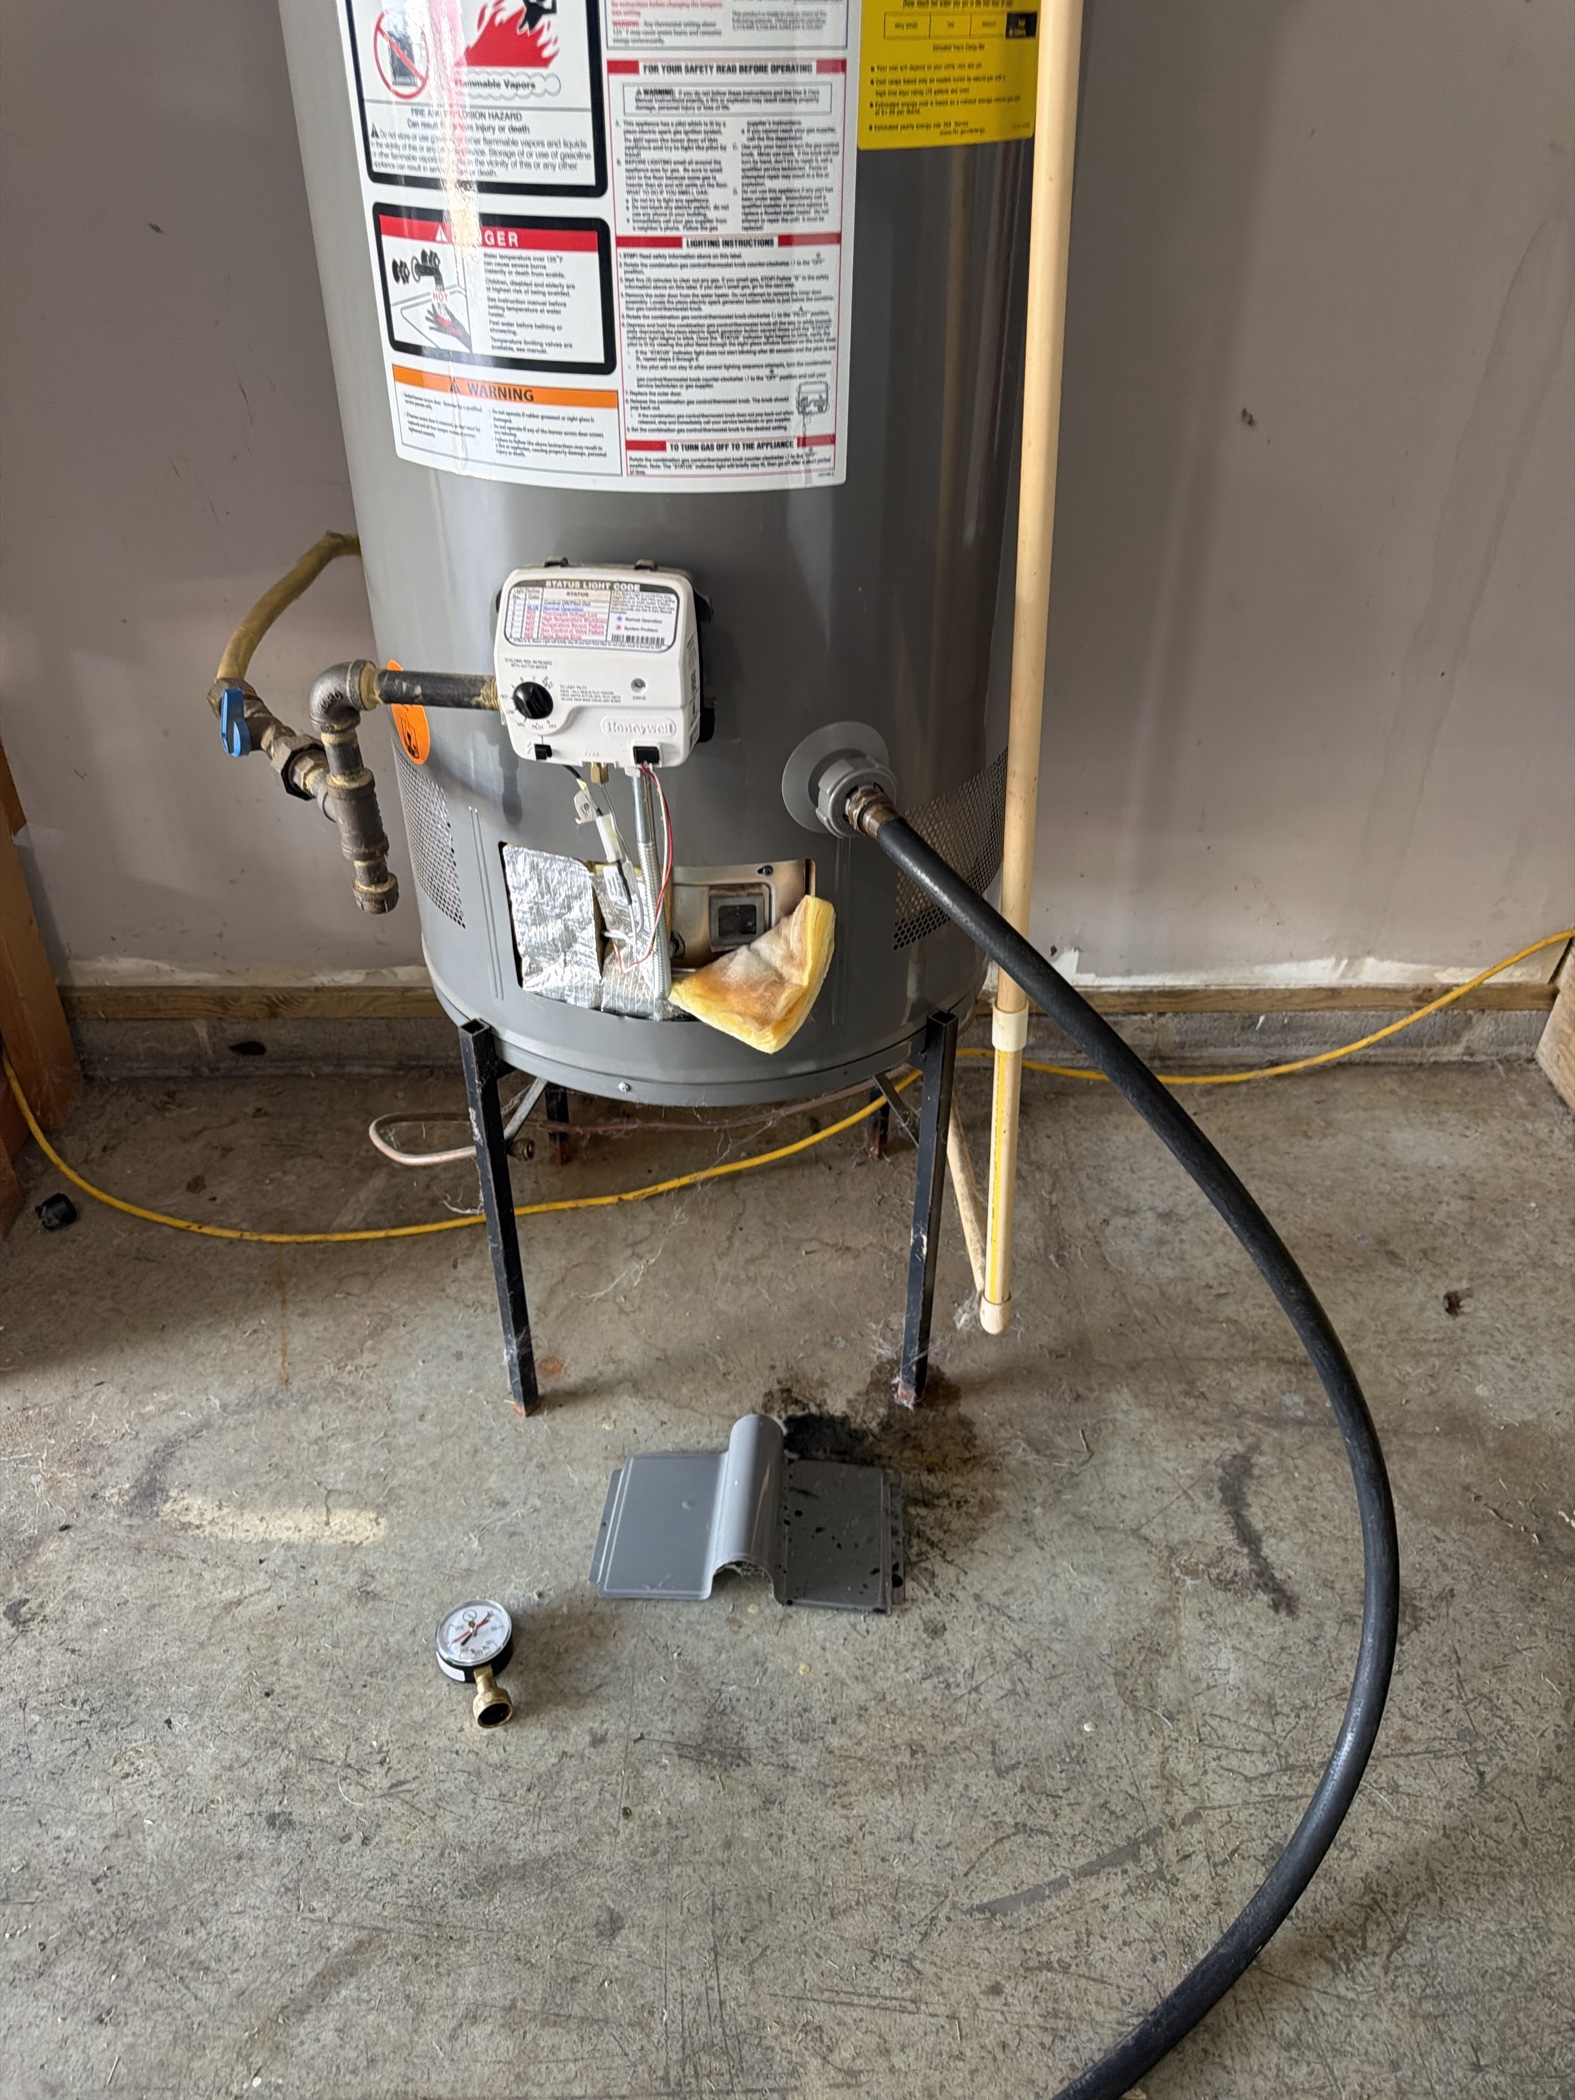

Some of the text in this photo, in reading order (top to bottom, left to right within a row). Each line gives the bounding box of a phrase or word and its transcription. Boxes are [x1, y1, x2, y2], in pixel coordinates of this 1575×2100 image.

[467, 381, 534, 403] WARNING
[670, 440, 794, 452] TO TURN GAS OFF TO THE APPLIANCE
[545, 580, 641, 592] STATUS LIGHT CODE
[606, 720, 673, 736] Honeywell
